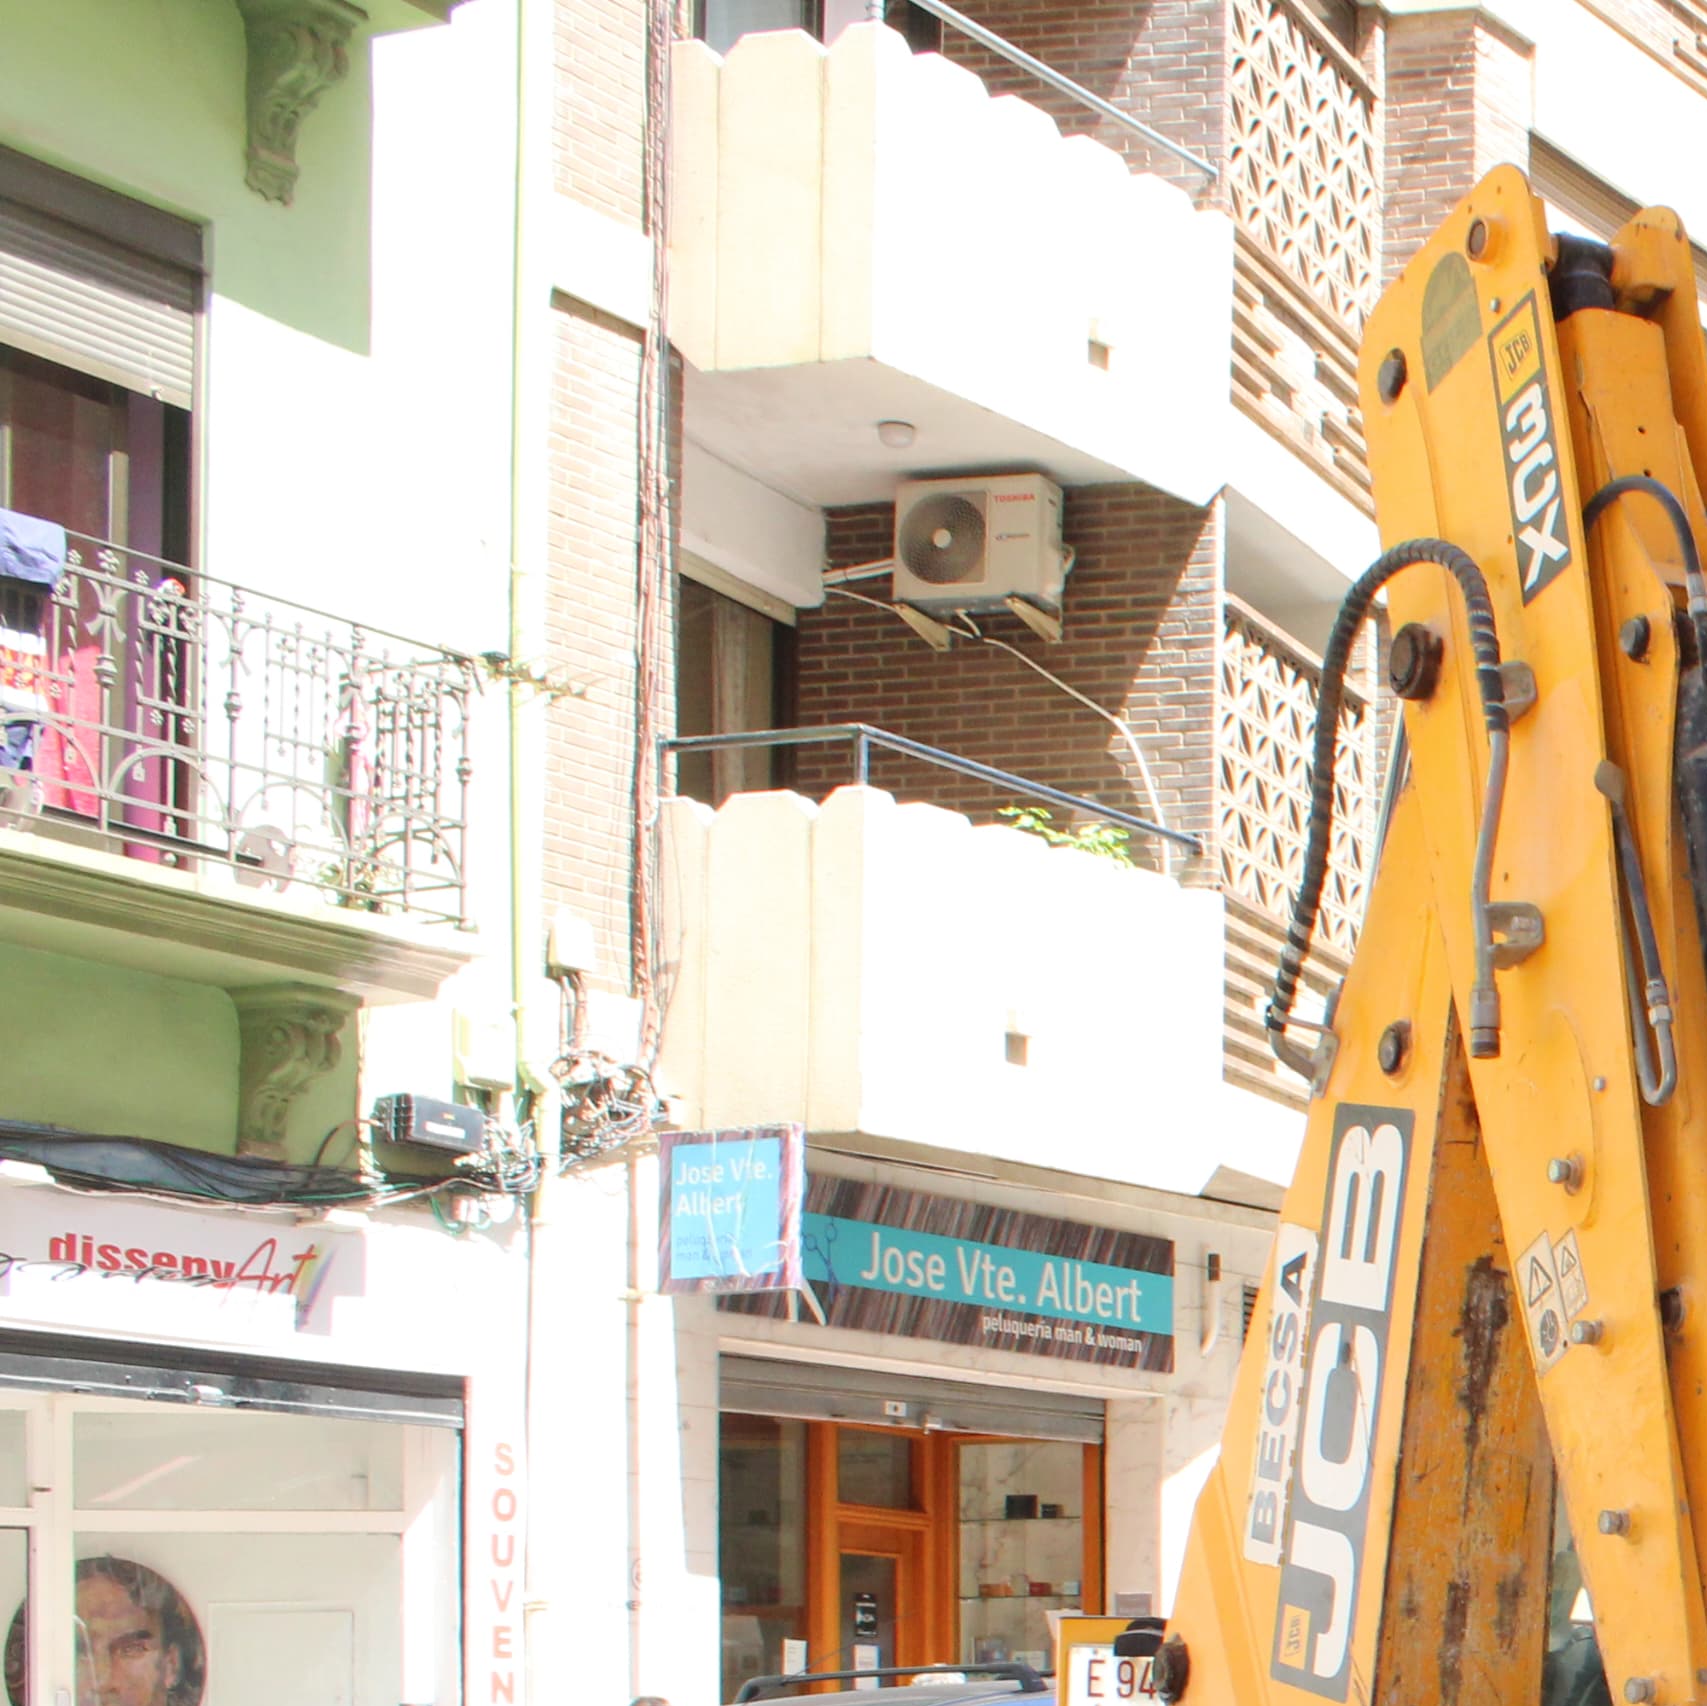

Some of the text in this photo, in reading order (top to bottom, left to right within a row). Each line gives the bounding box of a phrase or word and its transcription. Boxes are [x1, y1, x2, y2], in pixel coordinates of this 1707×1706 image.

[1506, 334, 1531, 374] JCB
[1506, 382, 1569, 592] 3CX
[676, 1161, 725, 1185] Jose
[675, 1192, 744, 1217] Albert
[861, 1231, 1144, 1322] Jose Vte. Albert
[982, 1313, 1143, 1353] peluquería man & woman
[1251, 1251, 1308, 1543] BECSA
[1290, 1124, 1403, 1679] JCB
[1087, 1660, 1157, 1699] E 94
